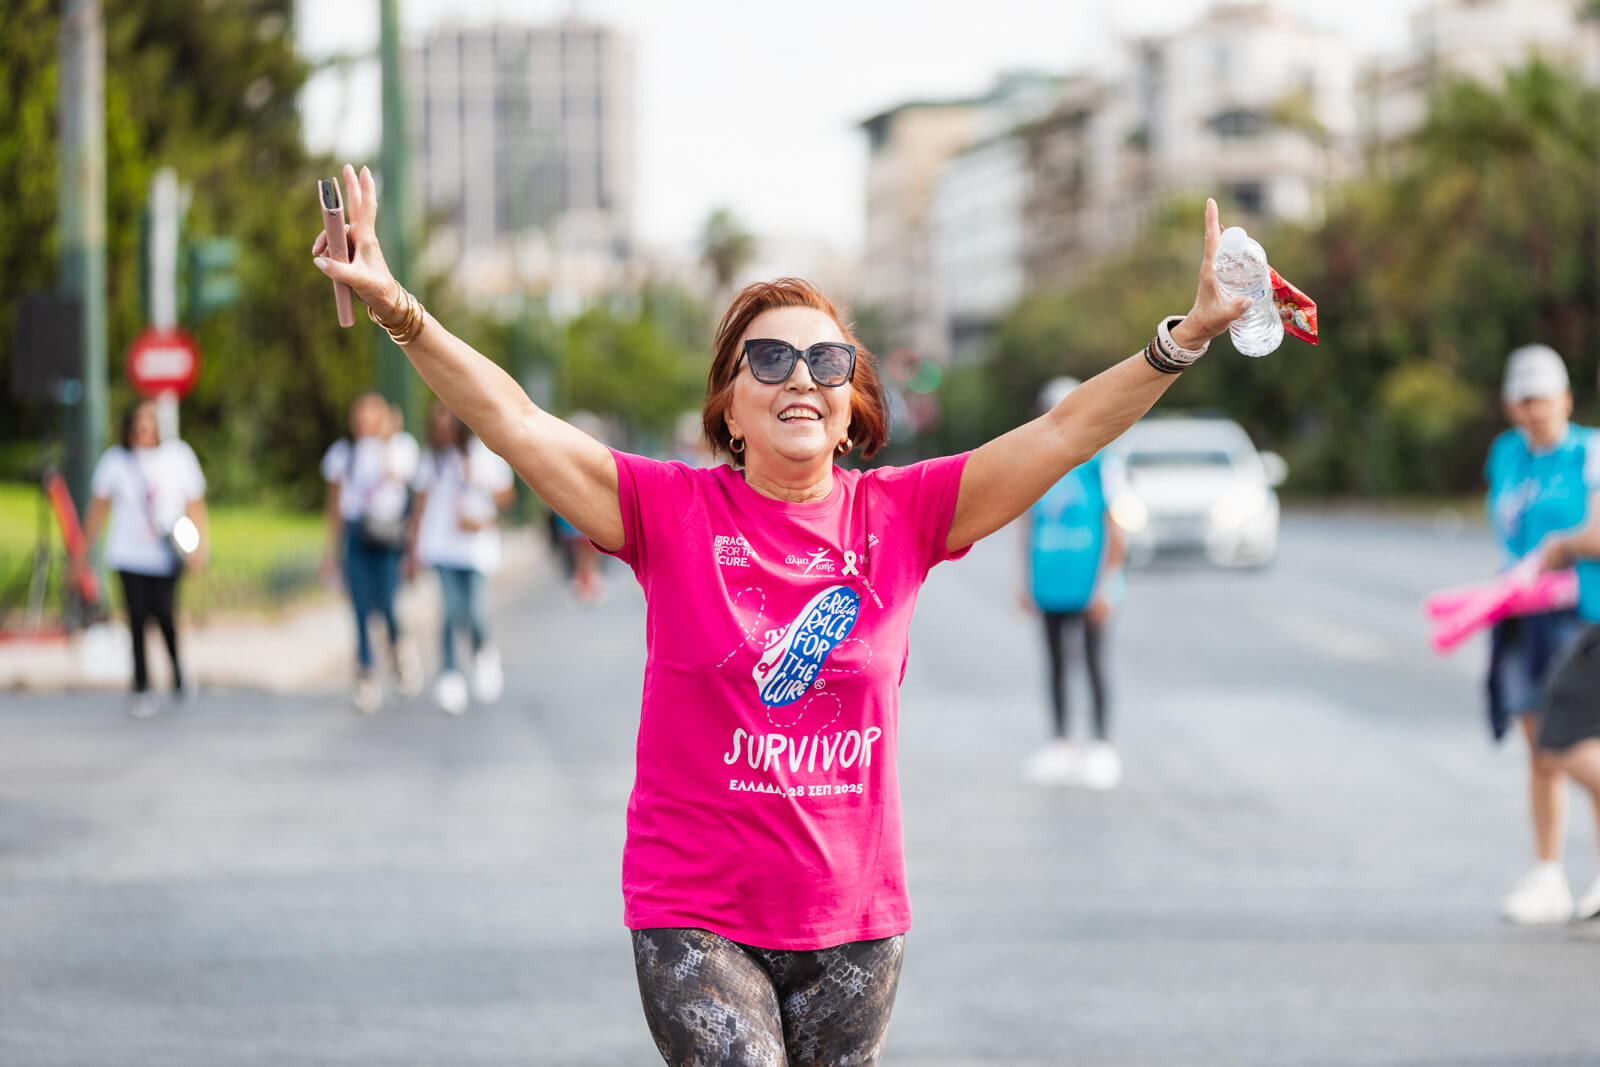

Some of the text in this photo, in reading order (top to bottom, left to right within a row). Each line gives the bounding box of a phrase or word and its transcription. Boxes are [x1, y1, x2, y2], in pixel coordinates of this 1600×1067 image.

[718, 556, 750, 568] CURE.
[721, 546, 741, 556] FOR
[819, 592, 857, 616] GREECE
[800, 608, 853, 641] RACE
[793, 631, 830, 663] FOR
[783, 651, 818, 682] THE
[764, 672, 810, 703] CURE
[723, 726, 882, 773] SURVIVOR
[788, 785, 805, 797] 28
[808, 784, 832, 797] ΣΕΠ
[834, 783, 864, 794] 2025
